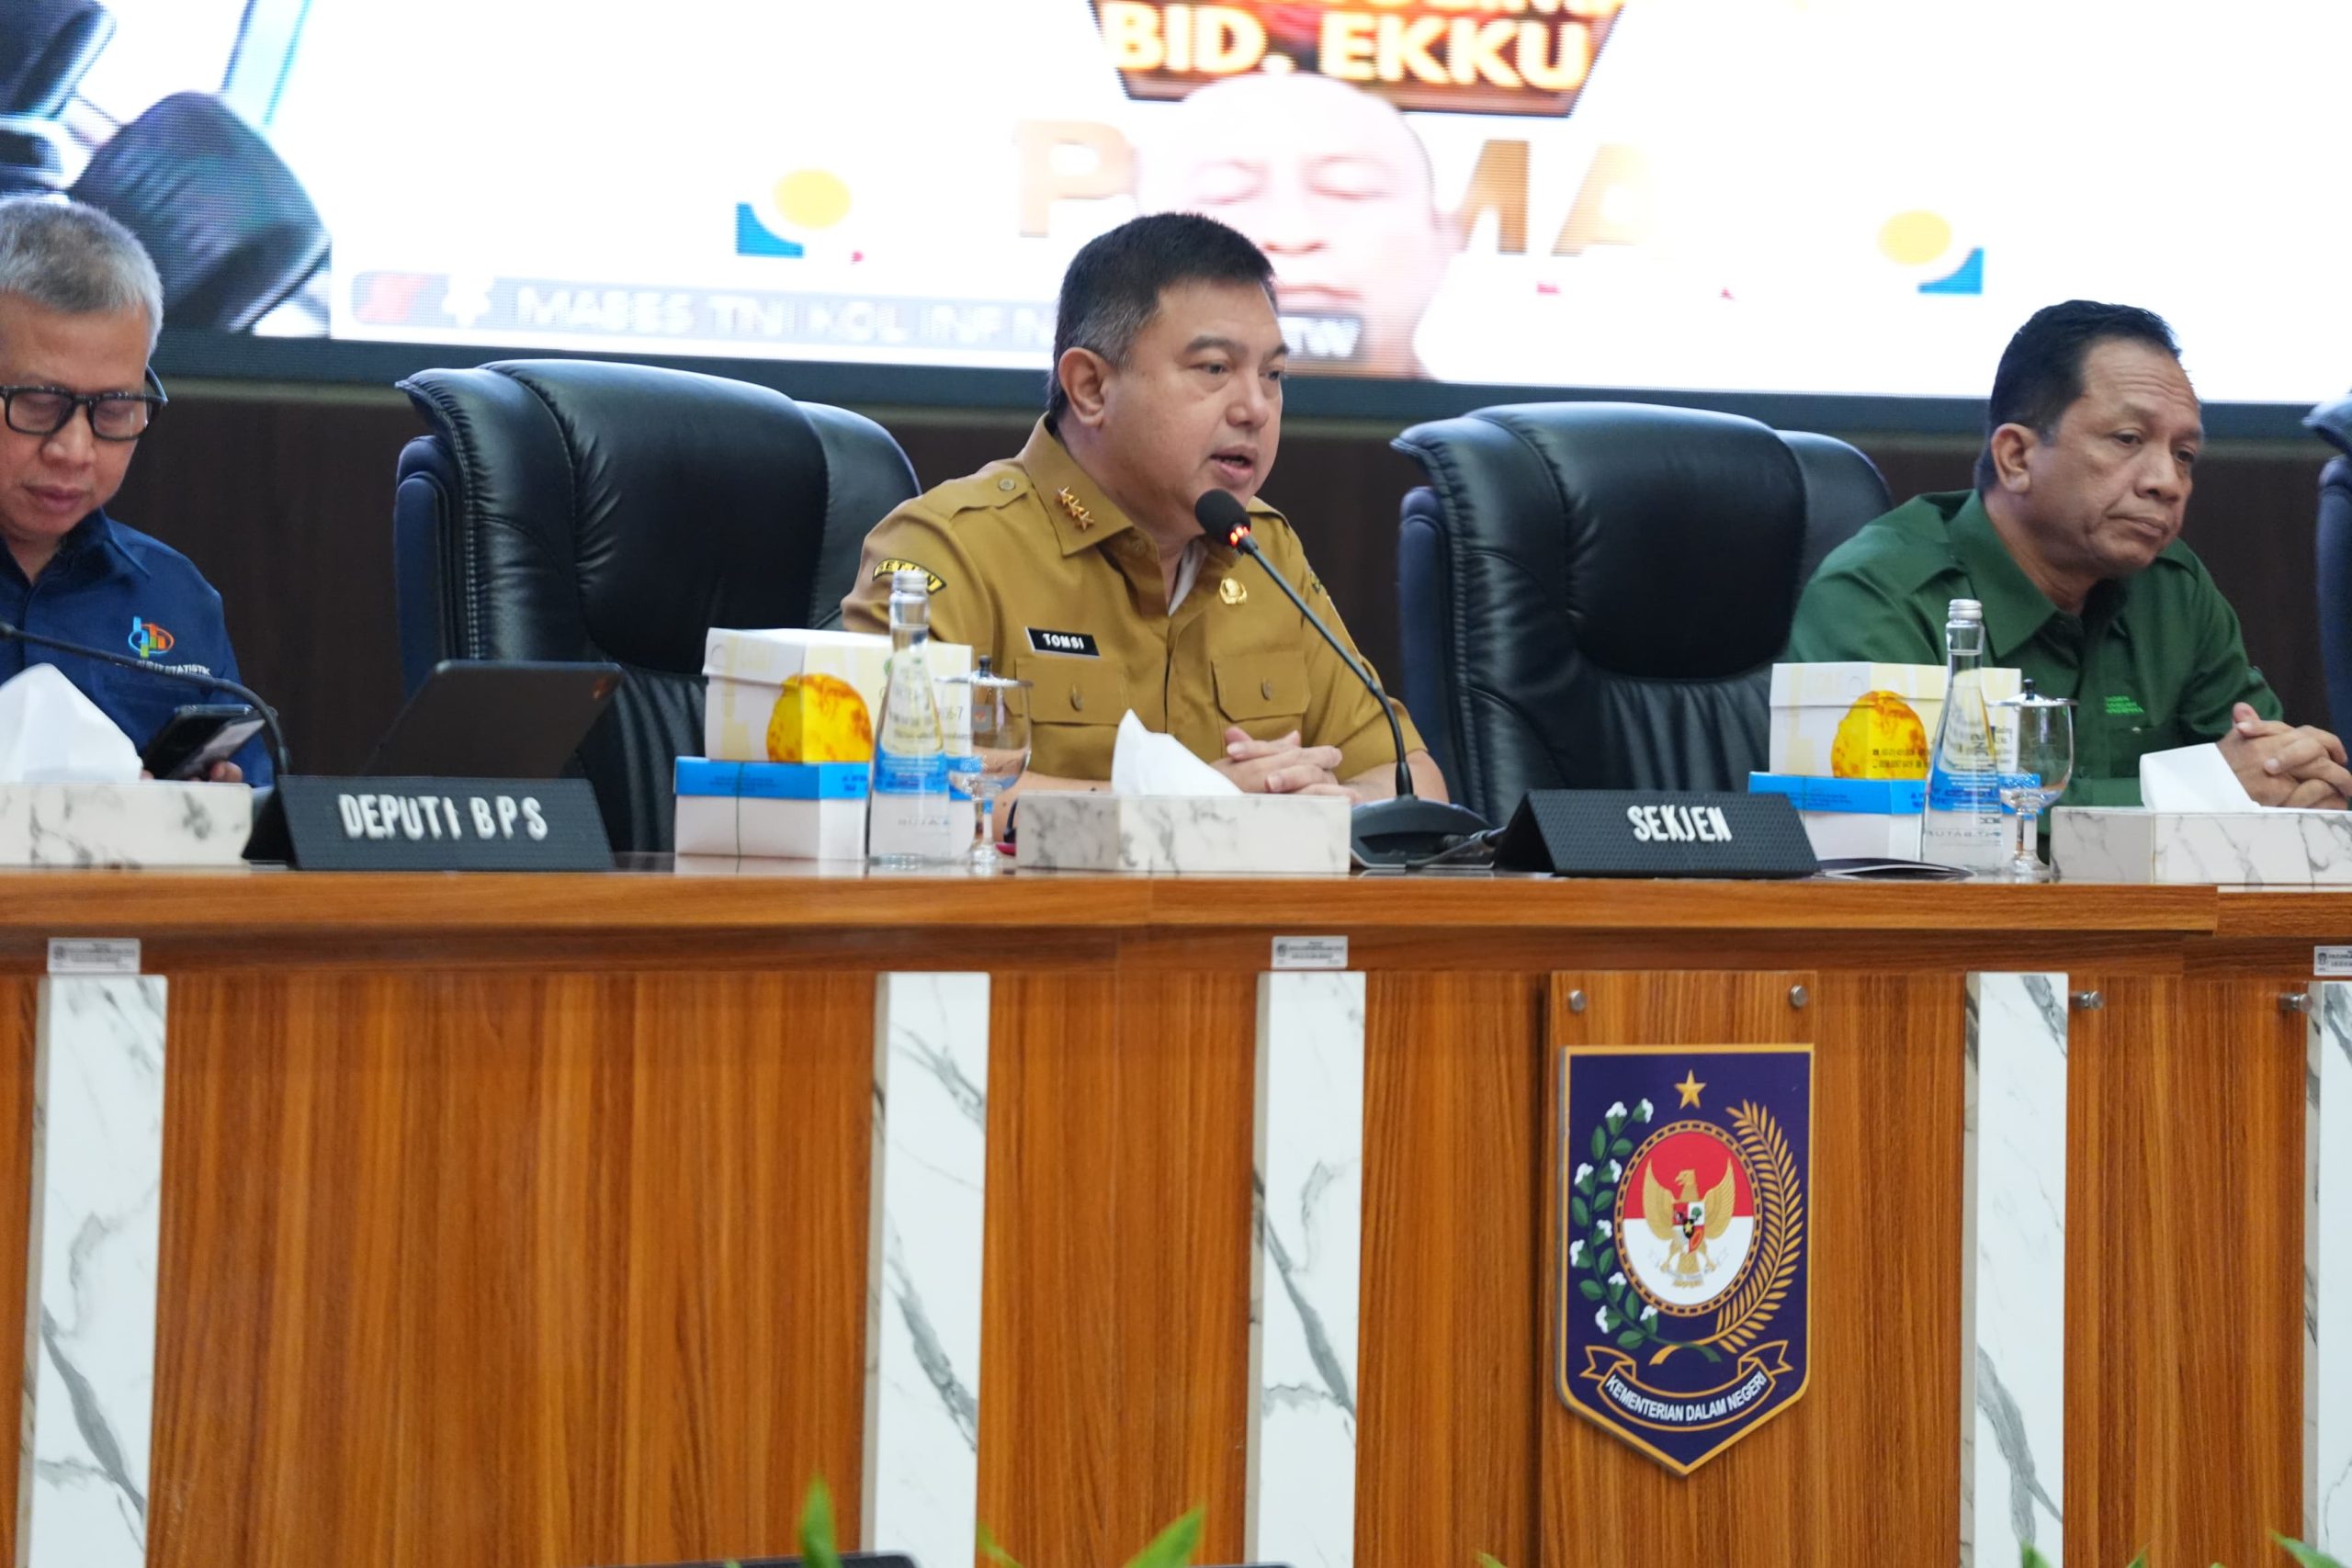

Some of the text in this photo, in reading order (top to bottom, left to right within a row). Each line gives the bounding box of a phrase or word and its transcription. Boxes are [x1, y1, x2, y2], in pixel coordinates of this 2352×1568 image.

[1106, 3, 1591, 89] BID. EKKU
[1042, 633, 1085, 649] TOMSI
[338, 794, 548, 840] DEPUTI BPS
[1626, 805, 1733, 842] SEKJEN
[1605, 1370, 1768, 1421] KEMENTERIAN DALAM NEGERI
